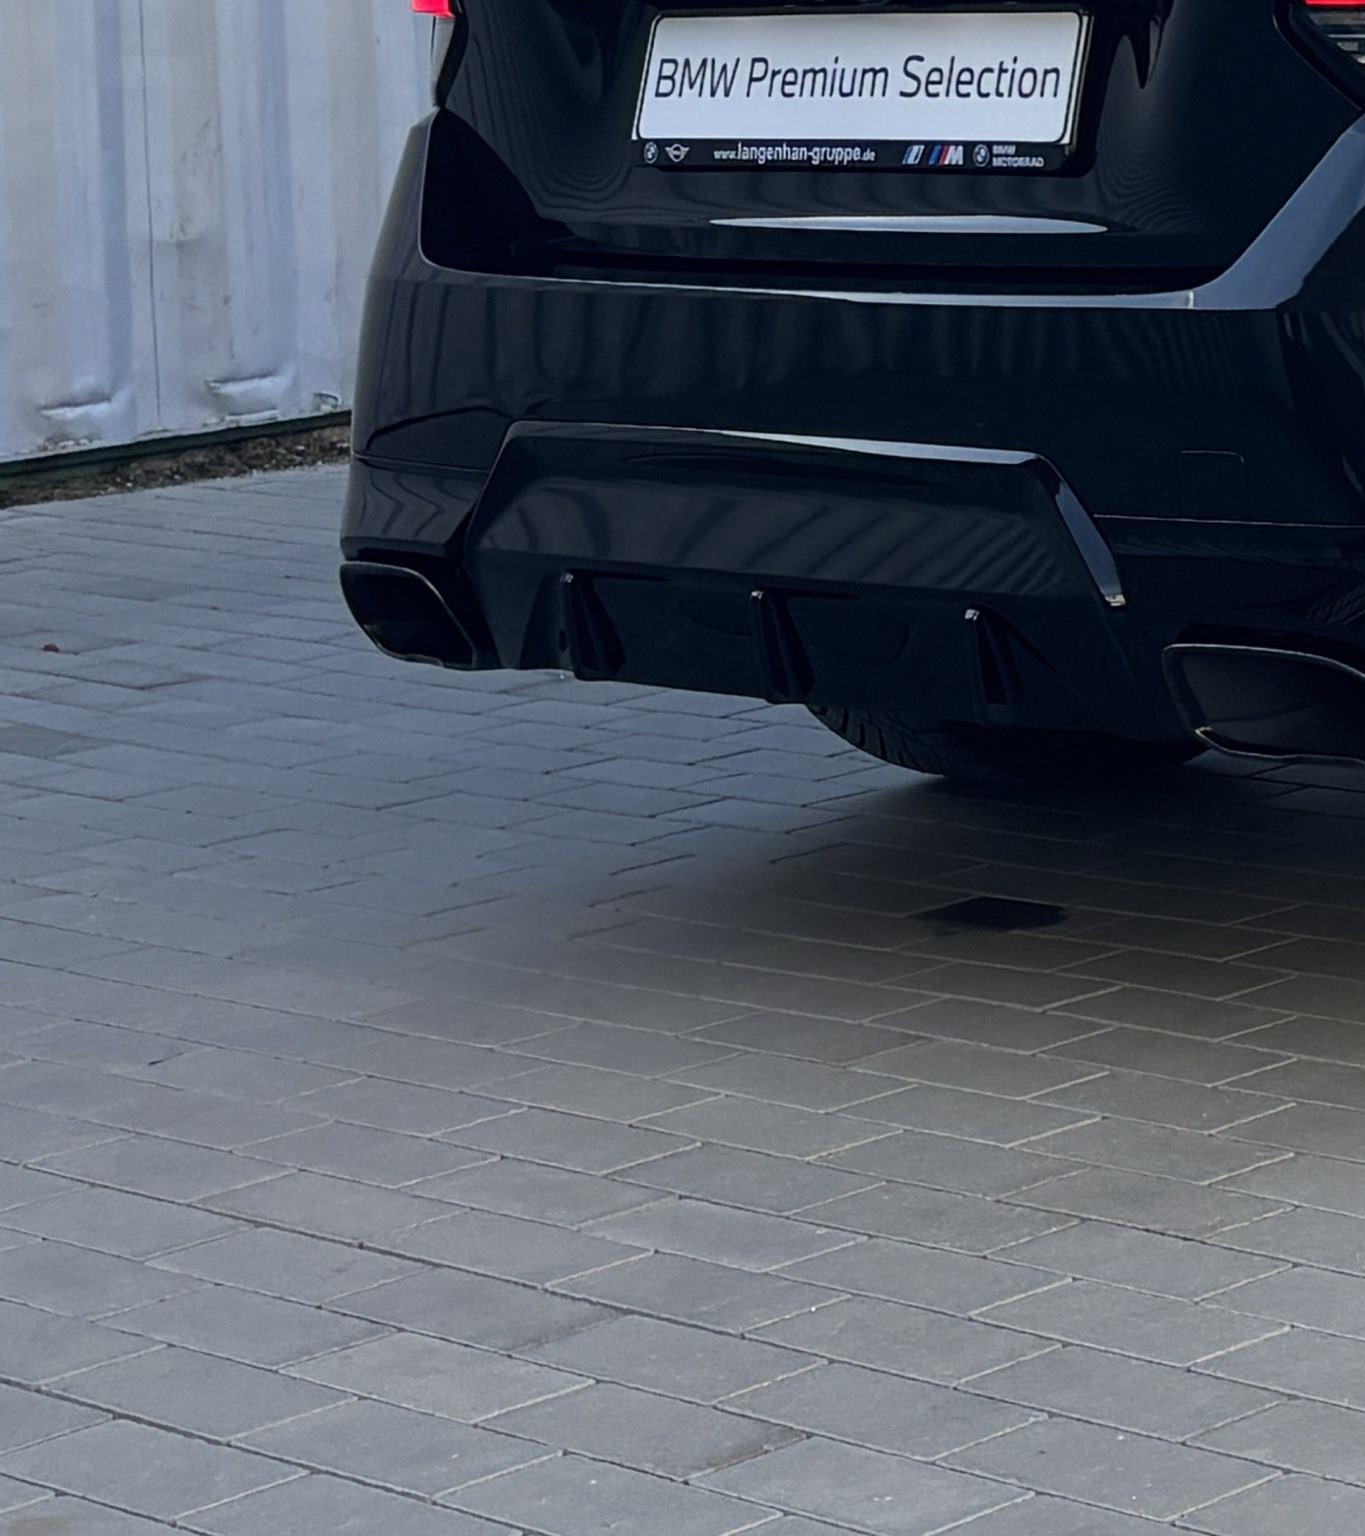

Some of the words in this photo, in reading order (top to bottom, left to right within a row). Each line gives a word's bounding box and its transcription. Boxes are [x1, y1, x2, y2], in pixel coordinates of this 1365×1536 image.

[654, 57, 740, 98] BMW
[746, 56, 889, 98] Premium
[899, 54, 1060, 99] Selection
[713, 142, 876, 165] www.langenhan-gruppe.de
